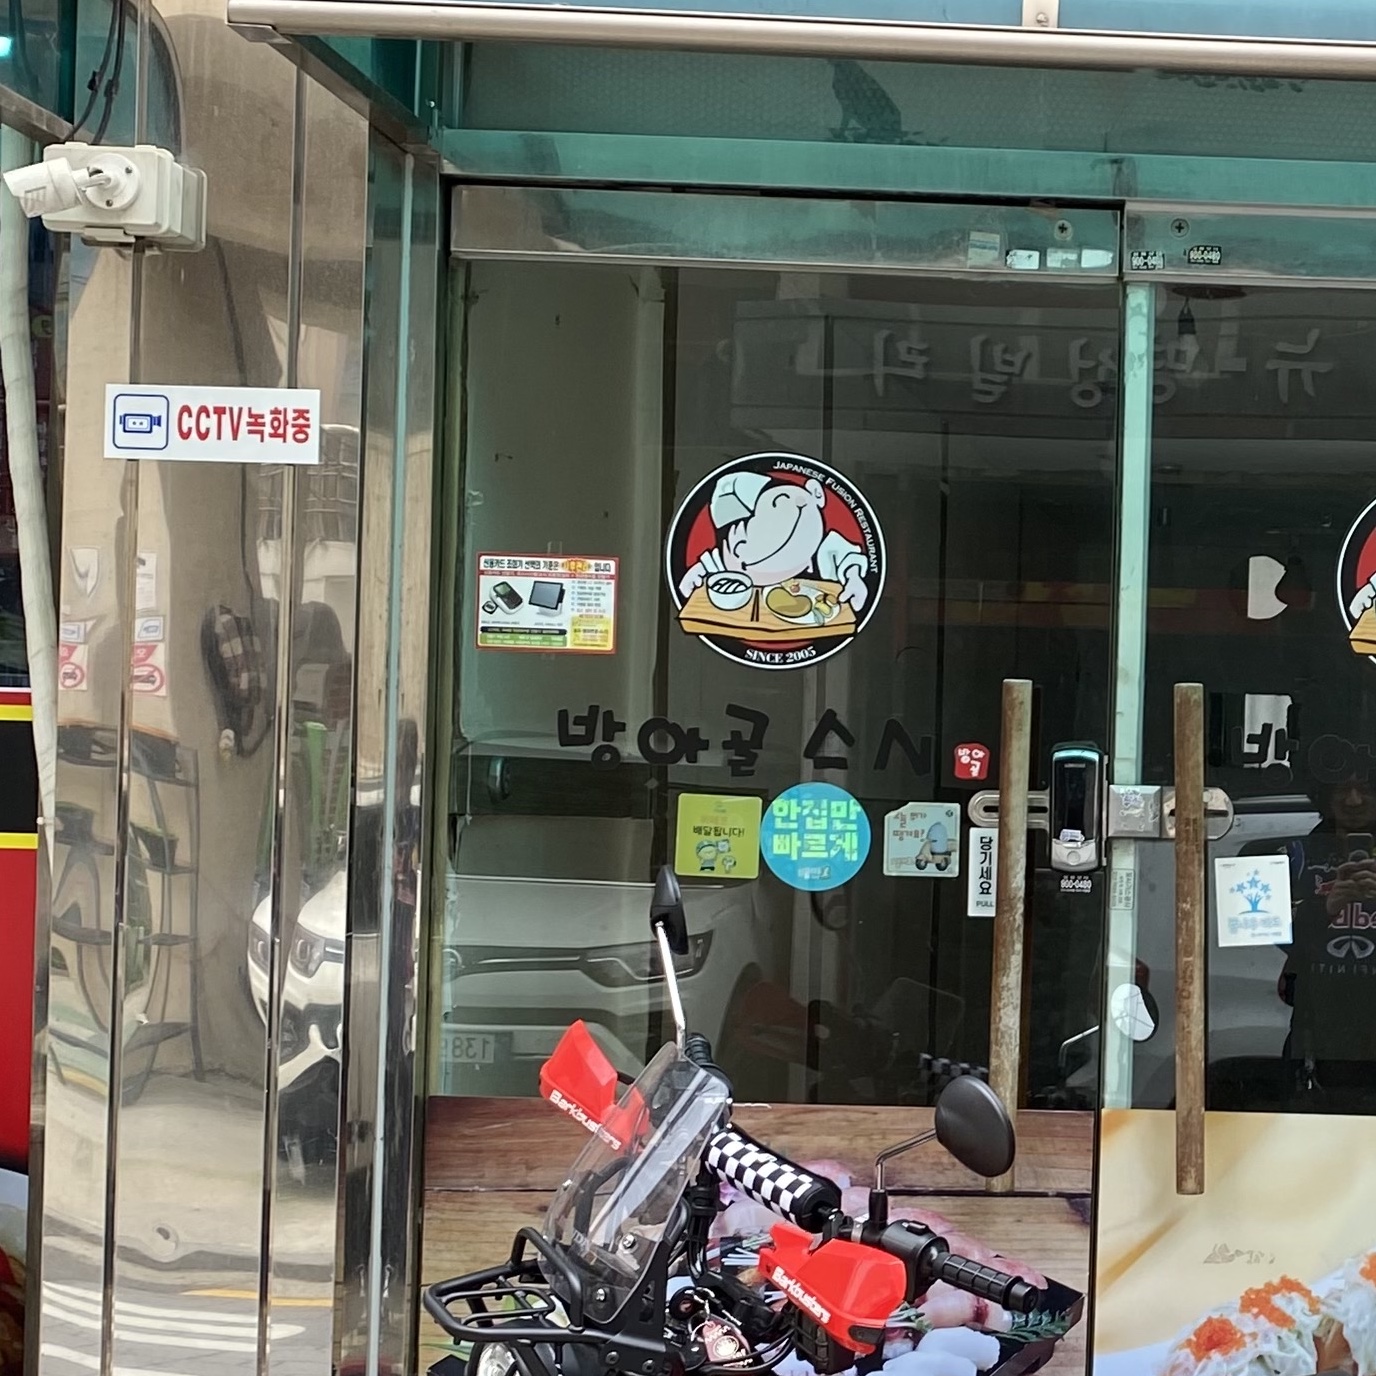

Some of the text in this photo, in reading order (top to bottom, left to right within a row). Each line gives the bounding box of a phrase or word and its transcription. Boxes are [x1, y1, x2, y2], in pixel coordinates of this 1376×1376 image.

[773, 460, 879, 573] JAPANESE FUSION RESTAURANT
[744, 645, 816, 663] SINCE 2005
[557, 703, 769, 777] 방아골
[772, 799, 862, 830] 한집만
[772, 832, 859, 861] 빠르게
[978, 836, 994, 895] 당기세요
[976, 900, 994, 908] PULL
[549, 1089, 622, 1150] Barkbusters
[771, 1266, 831, 1324] Barkbusters
